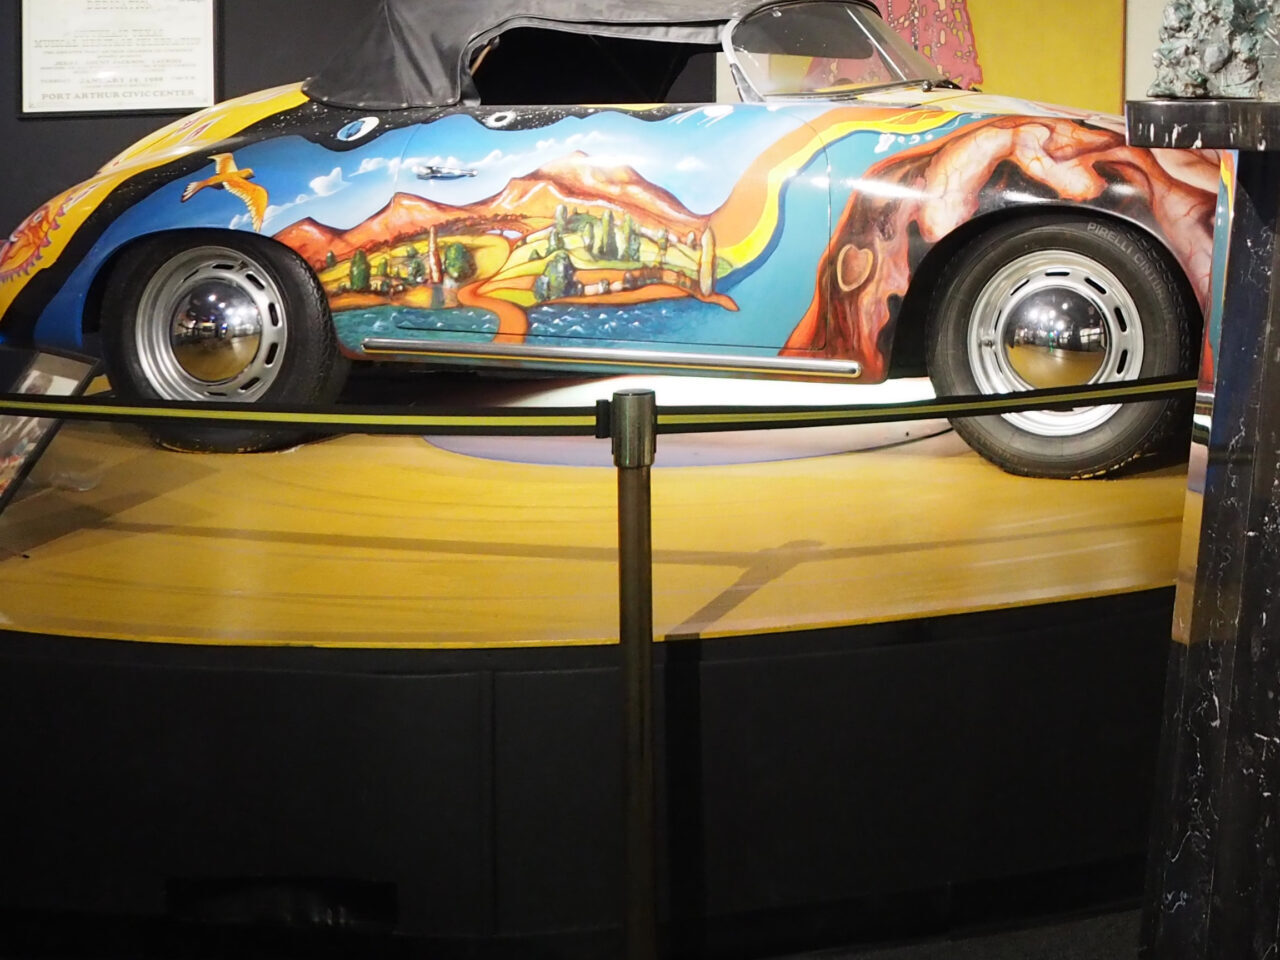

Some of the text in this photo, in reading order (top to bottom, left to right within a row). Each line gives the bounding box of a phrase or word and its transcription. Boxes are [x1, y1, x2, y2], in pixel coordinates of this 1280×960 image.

[41, 89, 195, 101] PORT ARTHUR CIVIC CENTER
[1087, 222, 1133, 255] PIRELLI
